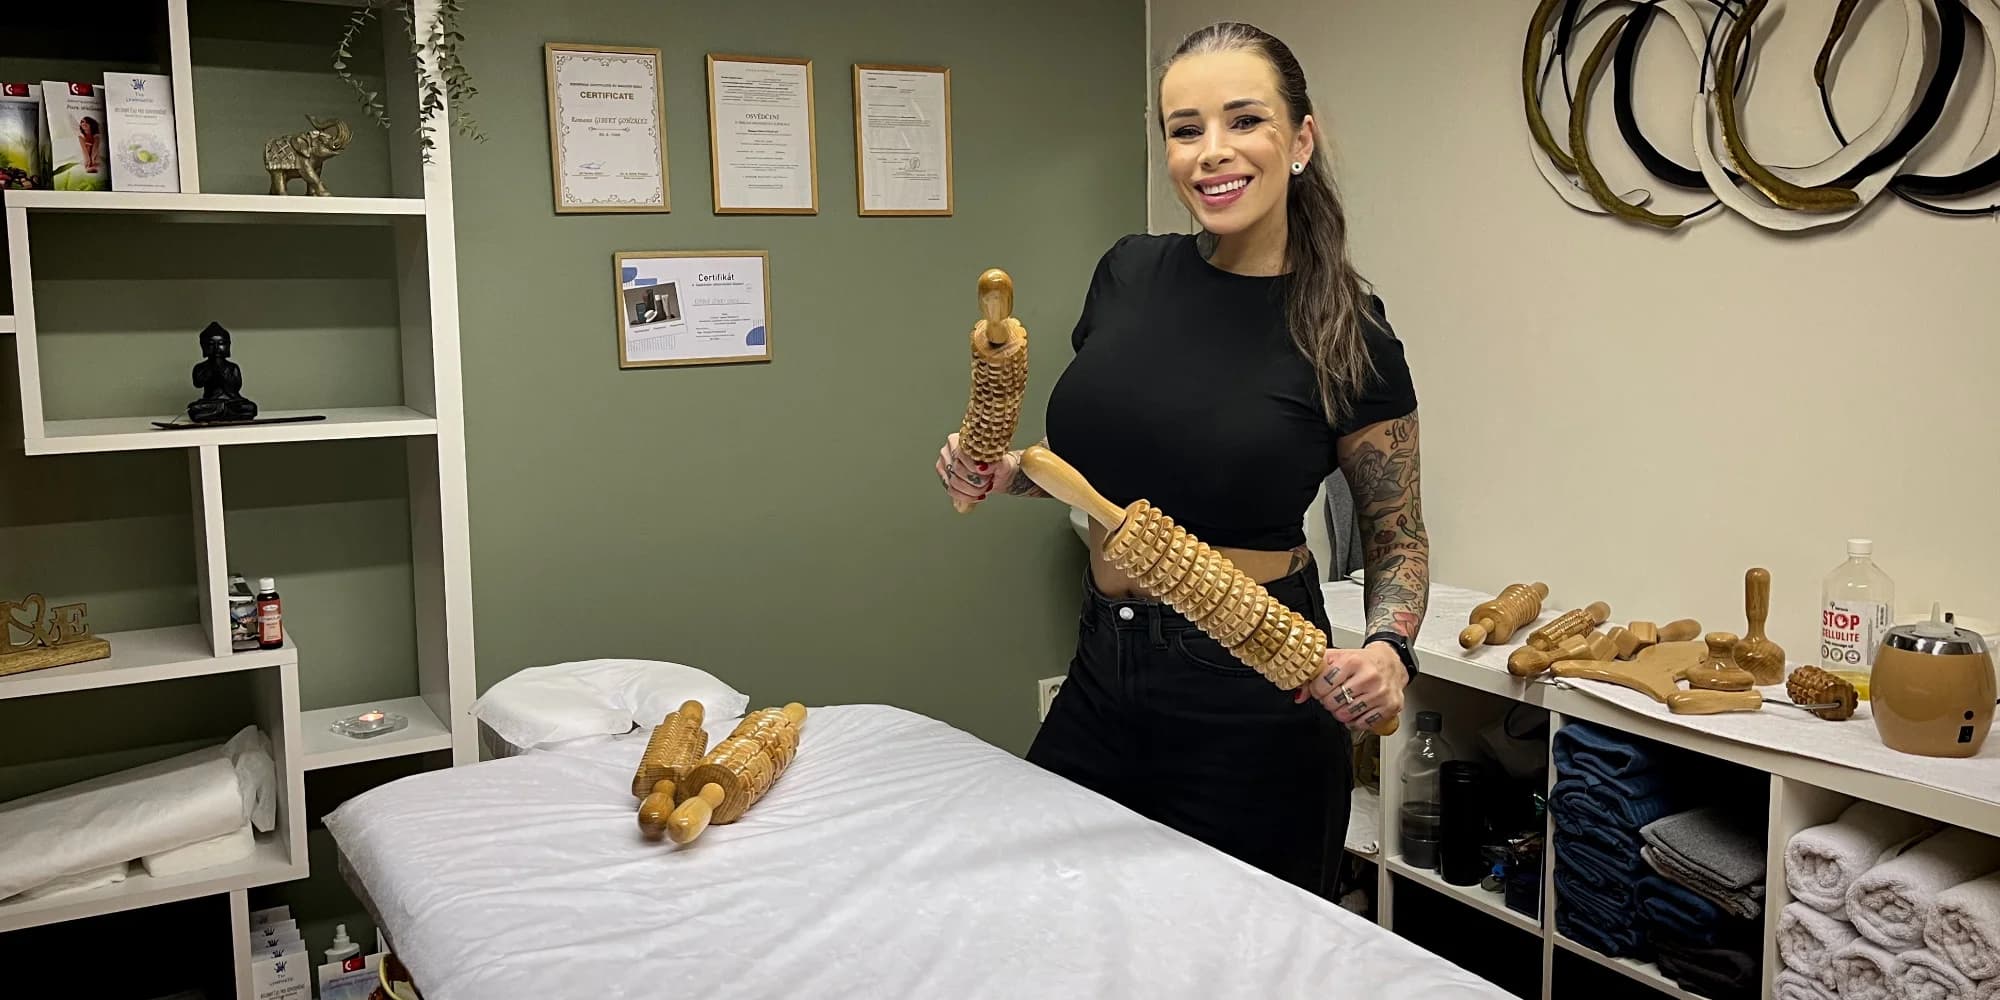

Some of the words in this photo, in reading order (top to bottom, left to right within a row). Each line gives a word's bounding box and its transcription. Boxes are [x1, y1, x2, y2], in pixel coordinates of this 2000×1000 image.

[580, 91, 634, 100] CERTIFICATE
[698, 272, 735, 282] Certifikát
[1823, 610, 1860, 630] STOP
[1822, 628, 1860, 642] CELLULITE
